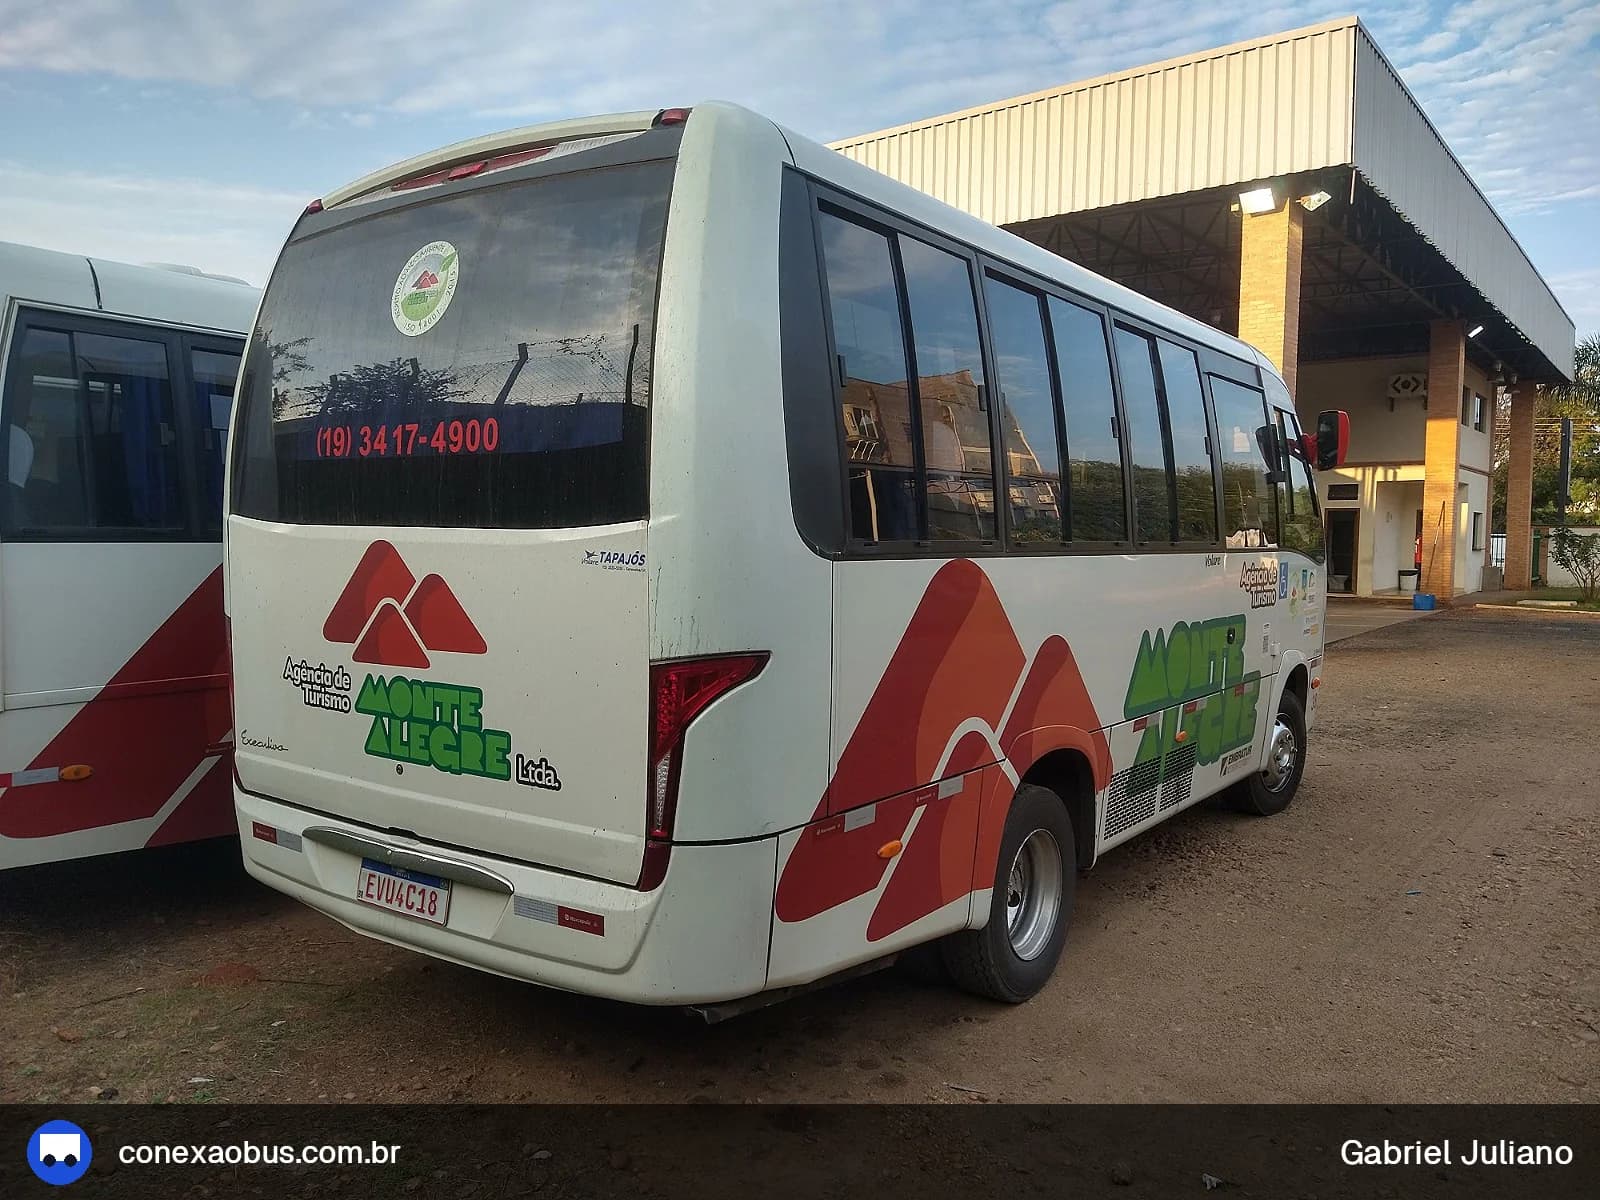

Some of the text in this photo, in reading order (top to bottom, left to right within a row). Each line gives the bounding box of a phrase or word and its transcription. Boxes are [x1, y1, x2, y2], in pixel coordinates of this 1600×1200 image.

[317, 417, 499, 457] (19) 3417-4900
[600, 551, 646, 566] TAPAJÓS
[1240, 560, 1268, 592] Agência
[1250, 588, 1276, 609] Turismo
[283, 655, 351, 691] Agência de
[1124, 614, 1246, 719] MONTE
[301, 684, 351, 713] Turismo
[355, 673, 483, 730] MONTE
[364, 714, 511, 781] ALEGRE
[516, 753, 561, 791] Ltda.
[365, 872, 438, 916] EVU4C18
